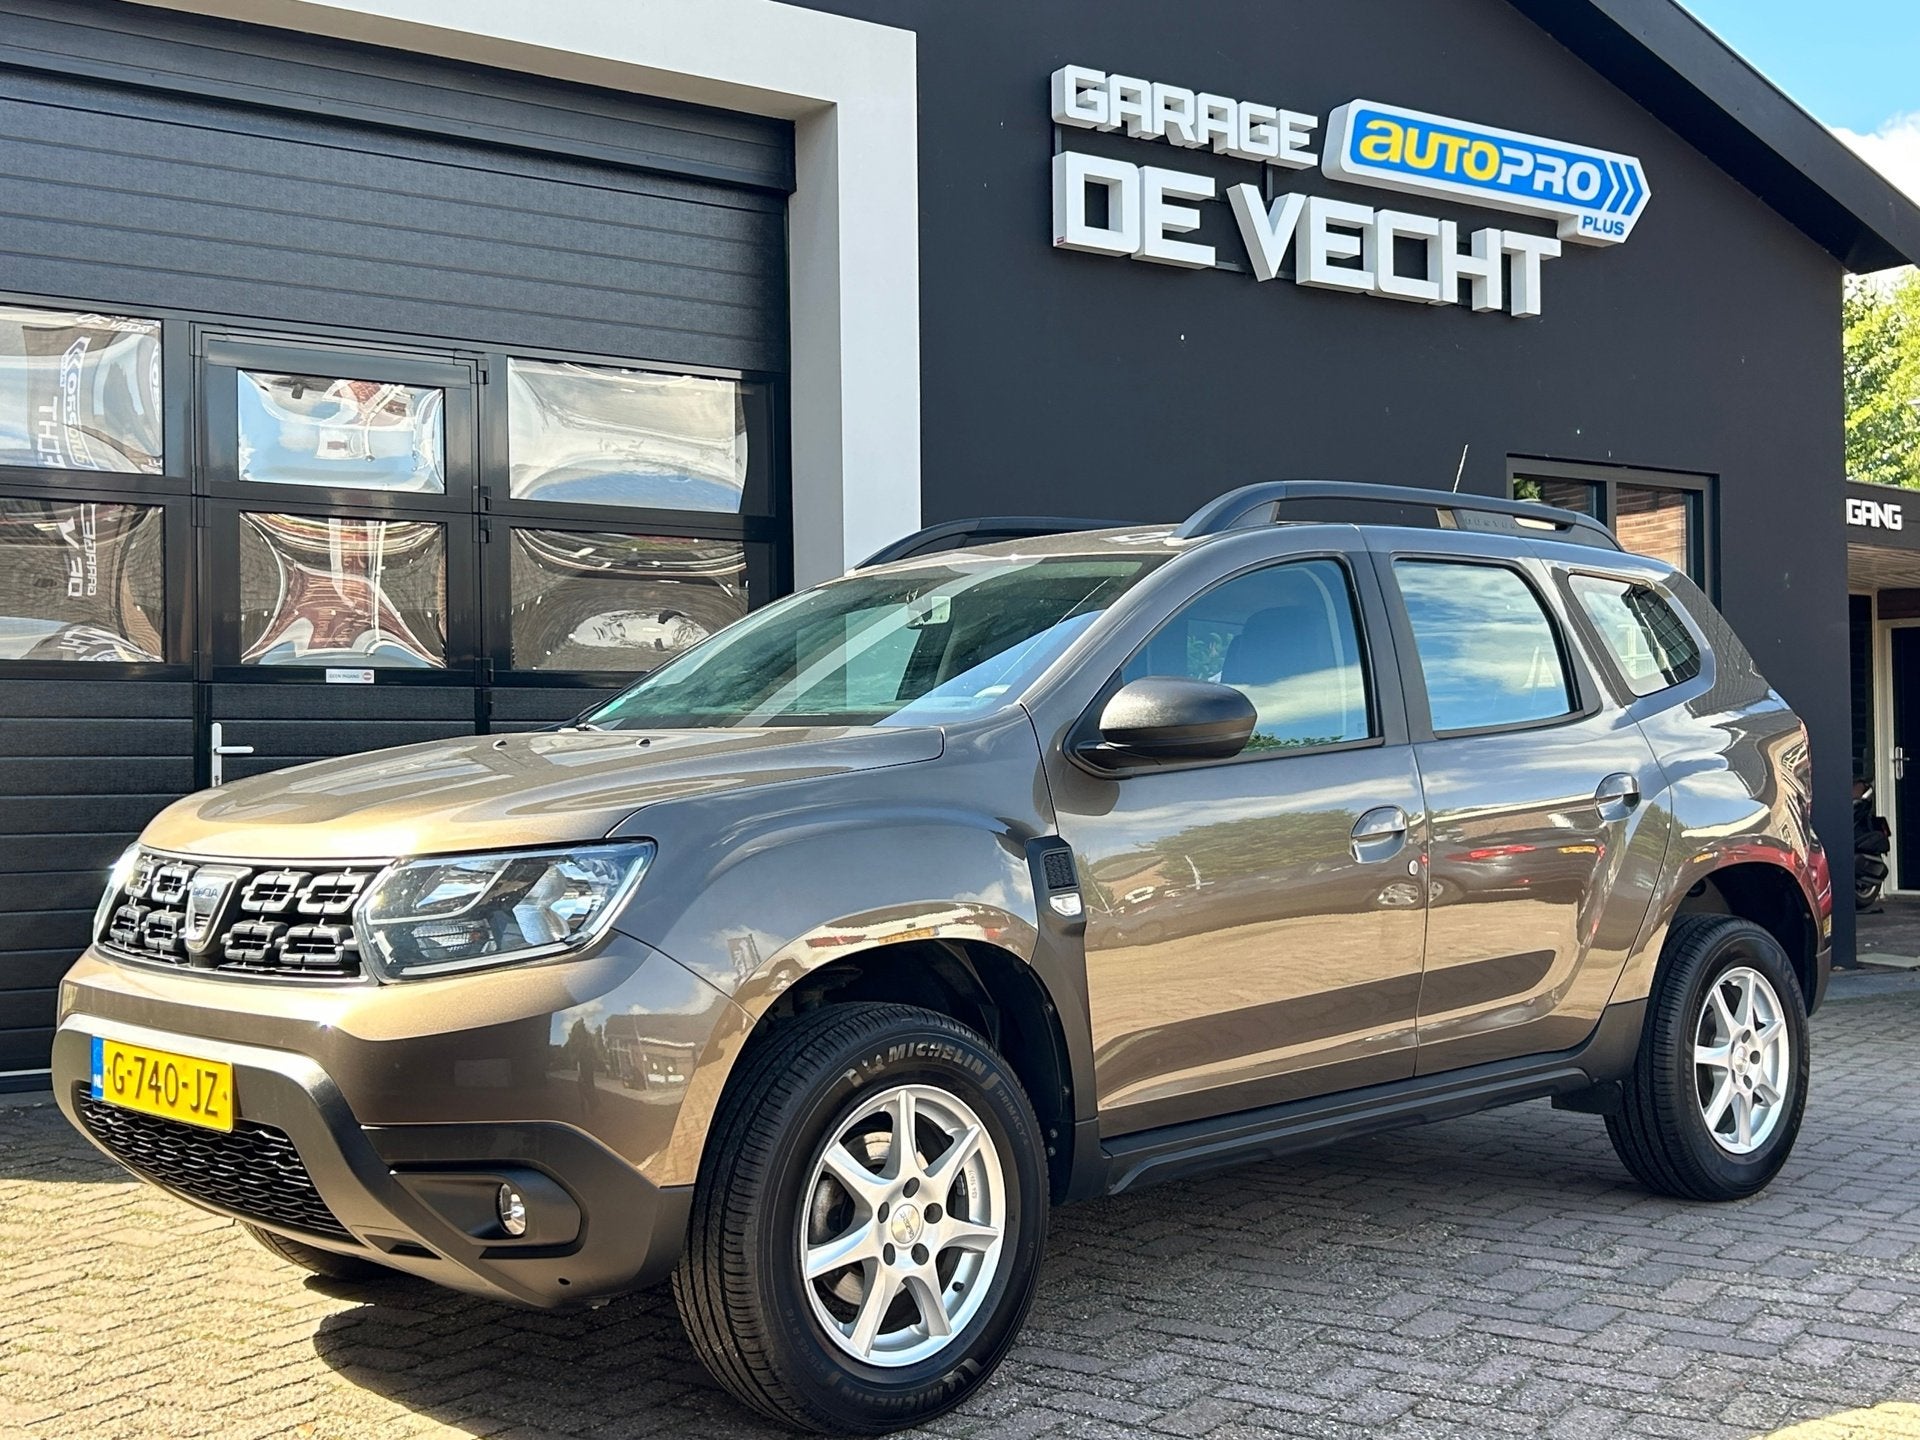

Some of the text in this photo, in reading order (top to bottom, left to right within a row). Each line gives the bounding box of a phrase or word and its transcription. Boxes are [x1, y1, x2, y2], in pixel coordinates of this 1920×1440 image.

[1051, 64, 1318, 169] GARAGE
[1053, 150, 1562, 319] DE VECHT
[1582, 215, 1625, 236] PLUS
[1846, 498, 1902, 530] GANG
[888, 1043, 987, 1076] MICHELIN
[92, 1074, 103, 1089] NL
[112, 1051, 219, 1117] G-740-JZ
[996, 1089, 1027, 1137] PRIMACY
